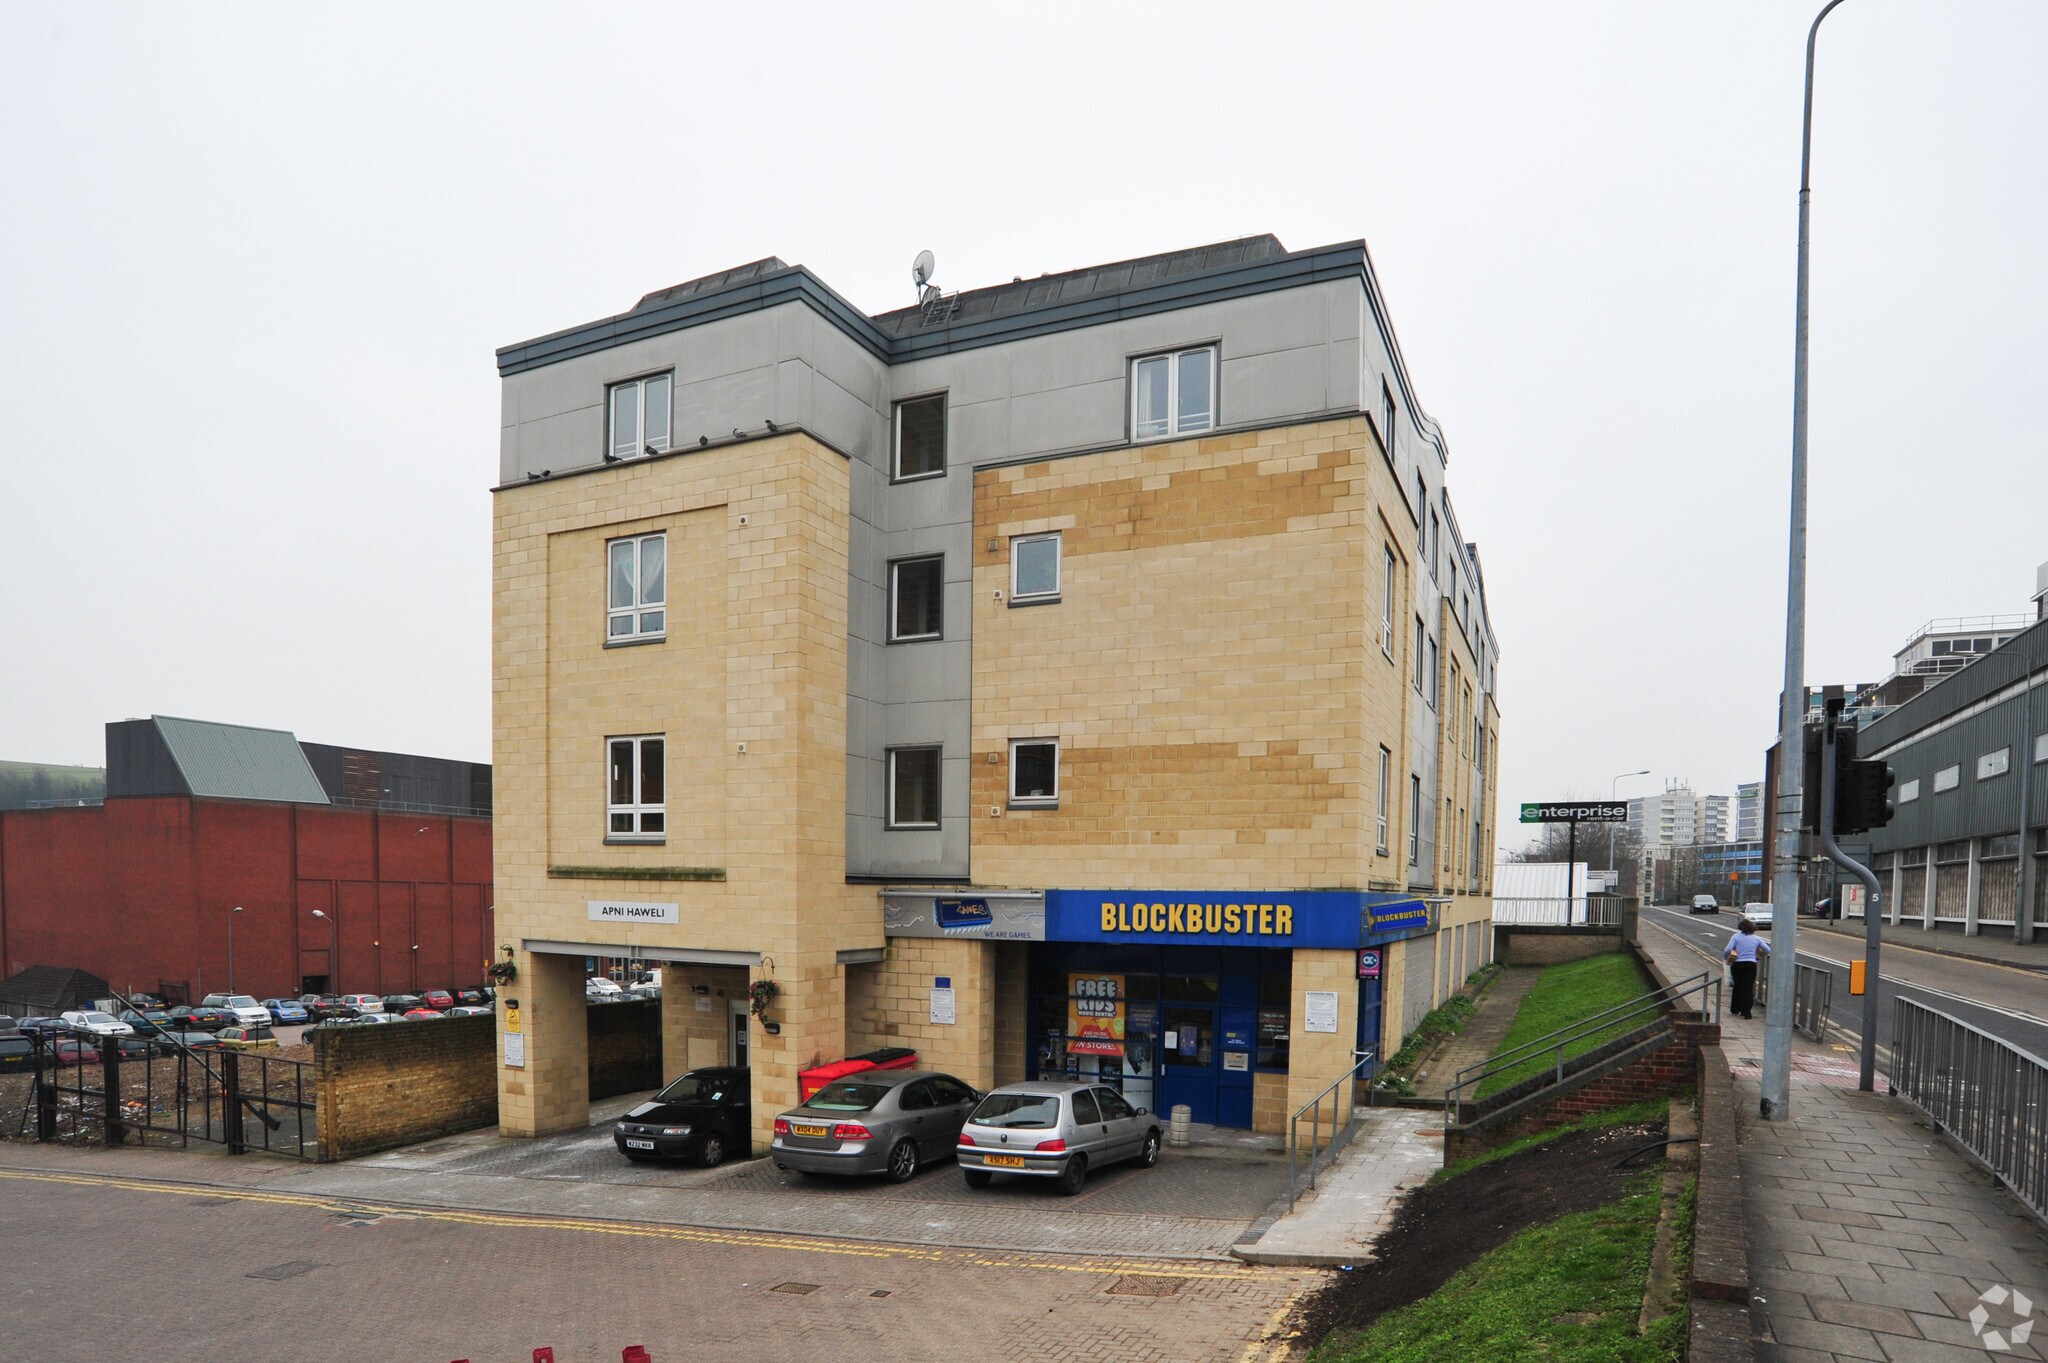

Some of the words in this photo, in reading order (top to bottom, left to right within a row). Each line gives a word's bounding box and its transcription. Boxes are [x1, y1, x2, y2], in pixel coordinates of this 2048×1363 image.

[1521, 804, 1625, 819] enterprise
[1872, 893, 1879, 902] 5
[601, 906, 624, 916] APNI
[626, 907, 665, 918] HAWELI
[1376, 909, 1426, 922] BLOCKBUSTER
[1101, 902, 1293, 935] BLOCKBUSTER
[1076, 979, 1117, 997] FREE
[1077, 999, 1115, 1011] KIDS
[1075, 1040, 1085, 1048] IN
[1086, 1041, 1117, 1050] STORE!
[1005, 1156, 1020, 1166] SHJ
